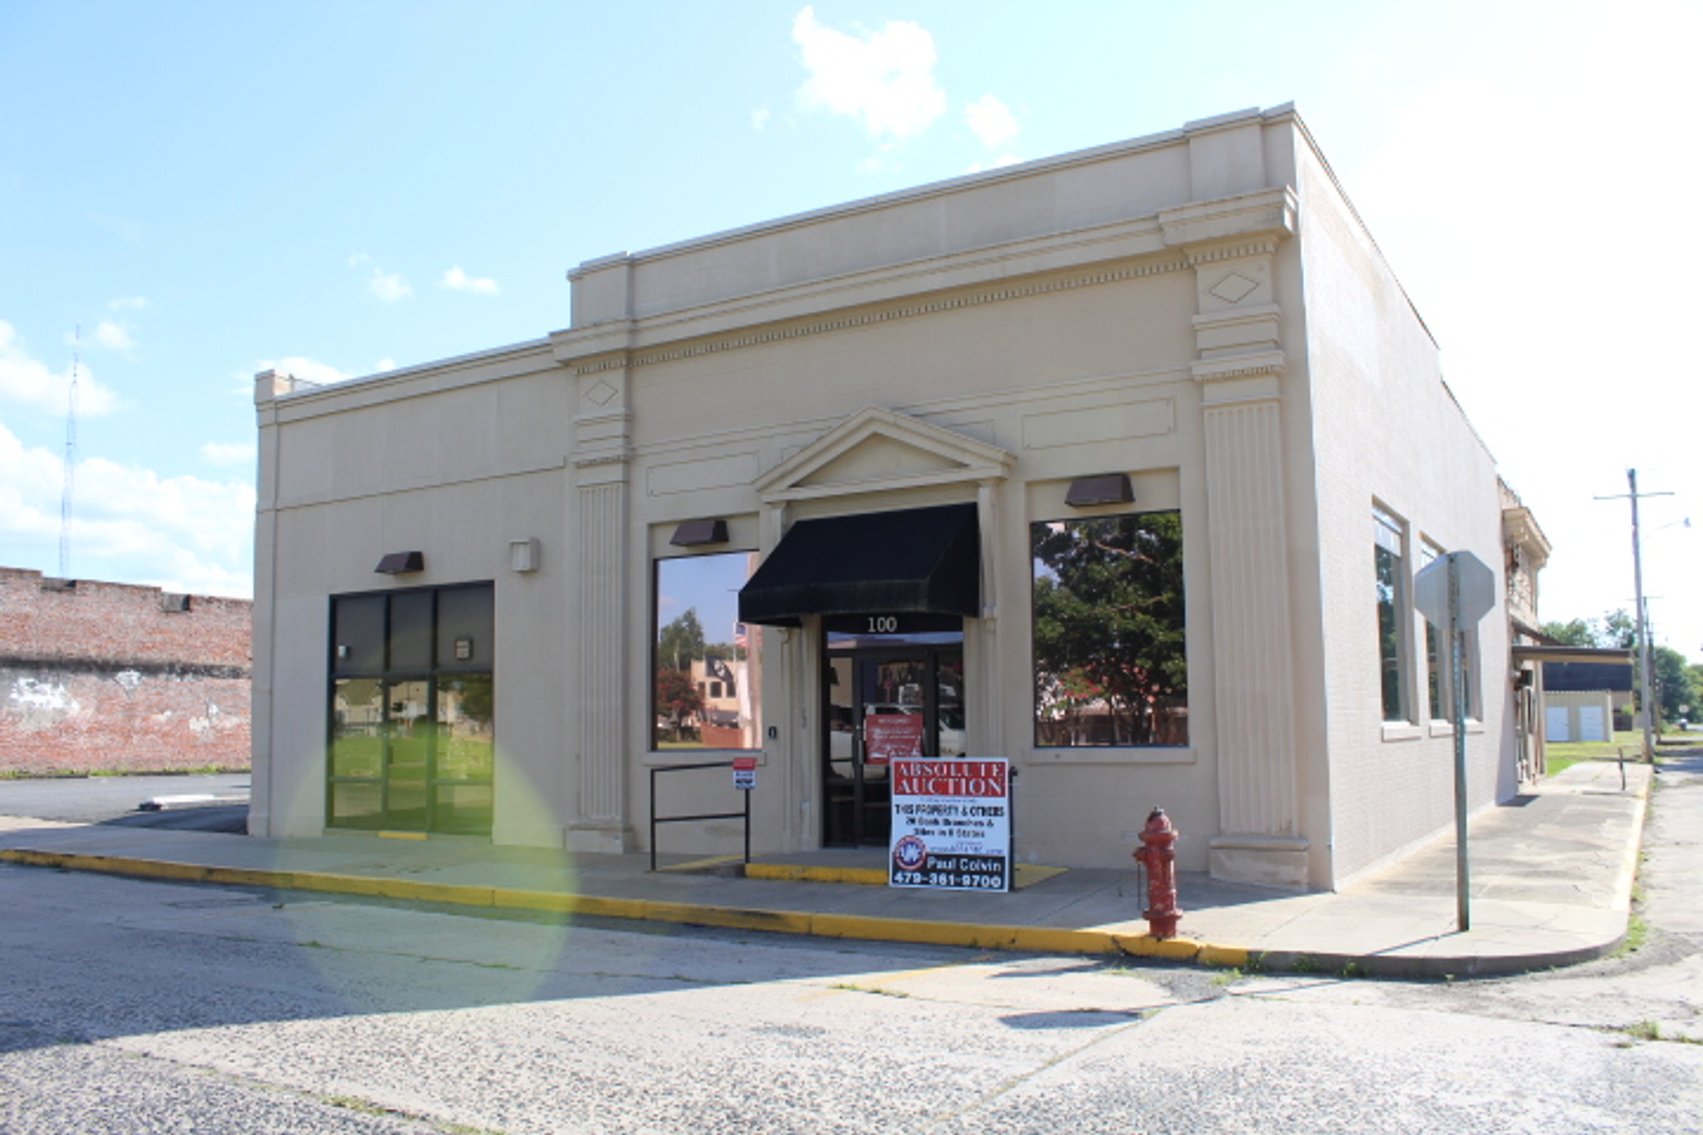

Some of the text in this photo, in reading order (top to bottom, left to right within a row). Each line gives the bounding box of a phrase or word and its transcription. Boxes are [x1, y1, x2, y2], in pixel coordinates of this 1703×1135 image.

[867, 616, 897, 632] 100
[899, 763, 1003, 777] ABSOLUTE
[896, 778, 1002, 795] AUCTION
[916, 804, 959, 816] PROPERTY
[961, 805, 968, 816] &
[970, 805, 1005, 817] OTHERS
[926, 856, 1002, 872] Paul Colvin
